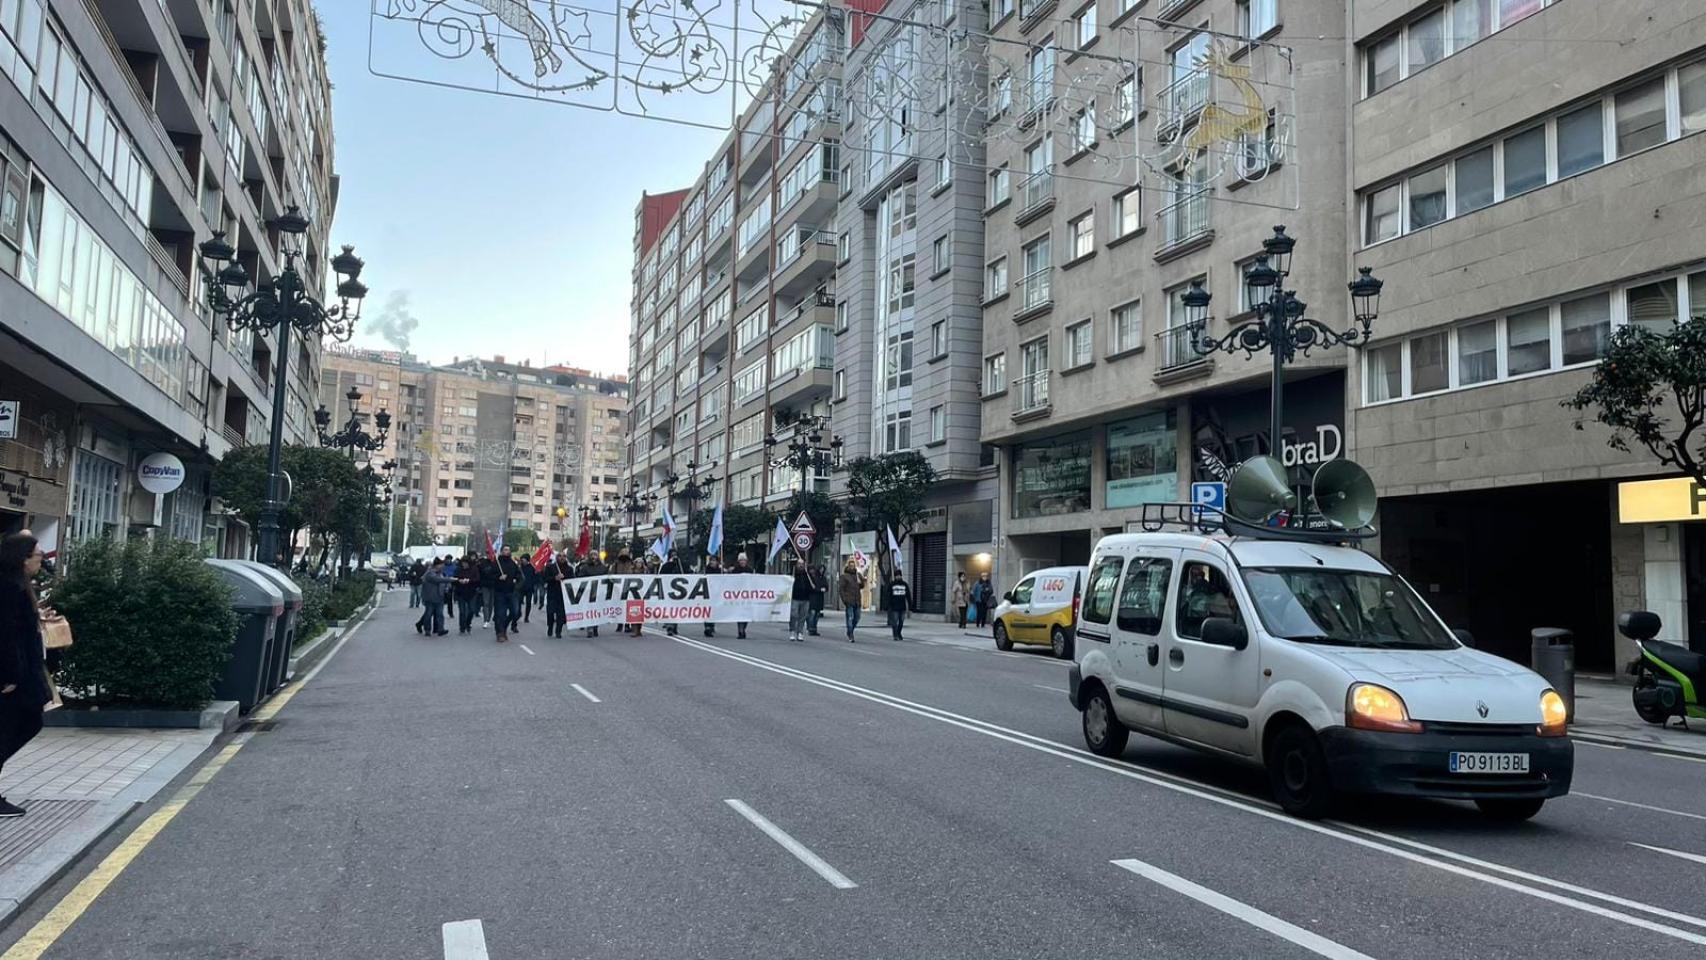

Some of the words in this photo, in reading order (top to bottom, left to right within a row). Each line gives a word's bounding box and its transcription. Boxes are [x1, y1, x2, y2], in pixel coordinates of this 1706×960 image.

[142, 465, 180, 476] CopyVan
[1196, 485, 1217, 509] P
[798, 536, 809, 545] 30
[564, 577, 711, 606] VITRASA
[723, 588, 775, 600] avanza
[644, 604, 712, 620] SOLUCIÓN
[1458, 754, 1476, 770] PO
[1478, 754, 1511, 771] 9113
[1512, 755, 1528, 771] BL
